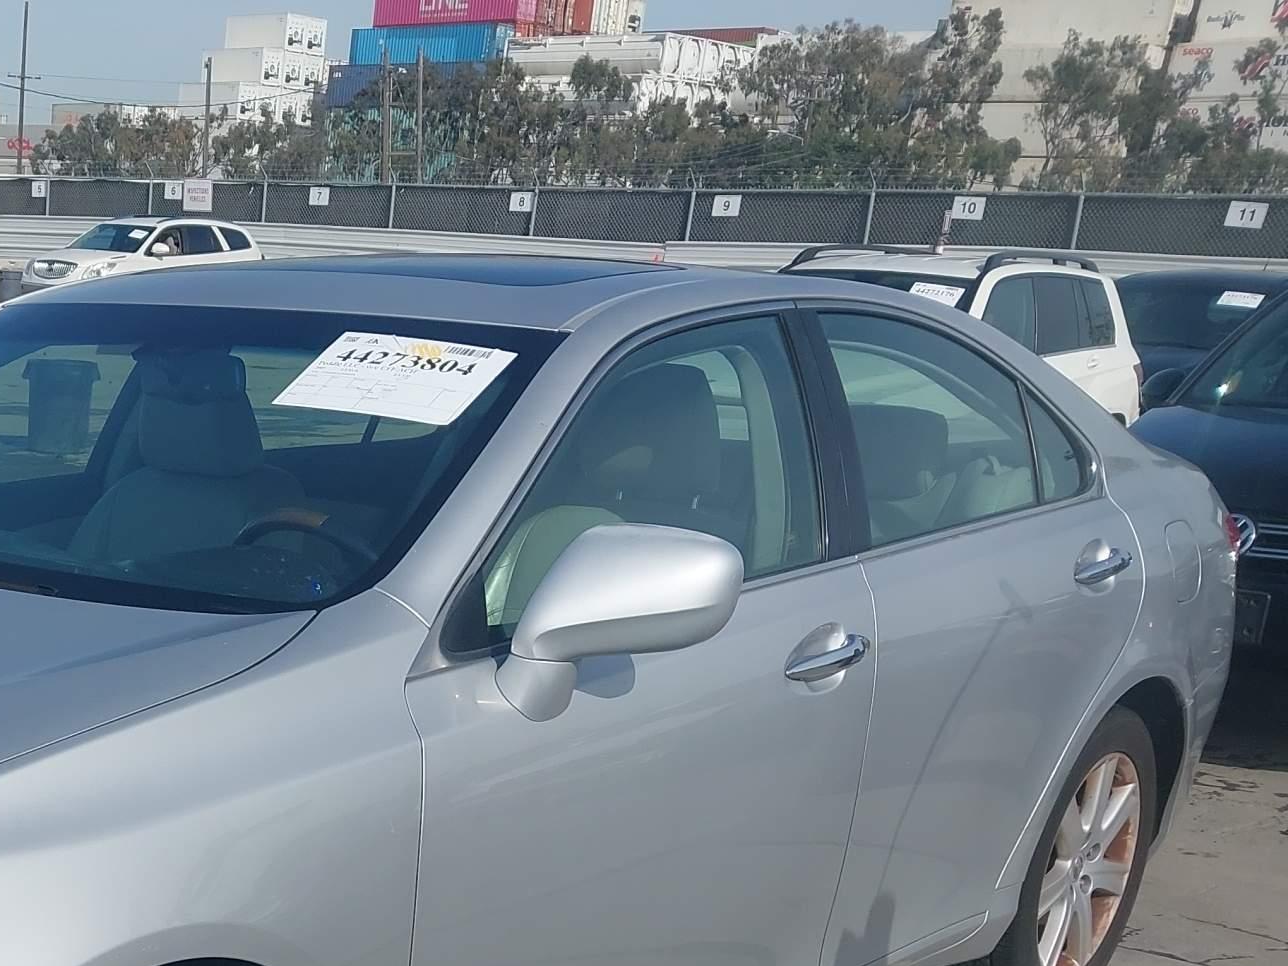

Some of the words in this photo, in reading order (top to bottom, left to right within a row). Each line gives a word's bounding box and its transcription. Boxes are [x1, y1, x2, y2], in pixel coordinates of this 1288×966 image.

[1182, 46, 1213, 58] seaco
[37, 182, 42, 193] 5
[170, 186, 177, 196] 6
[316, 191, 322, 201] 7
[518, 197, 525, 207] 8
[723, 200, 731, 212] 9
[960, 202, 977, 215] 10
[1239, 208, 1257, 222] 11
[336, 349, 477, 376] 44273804
